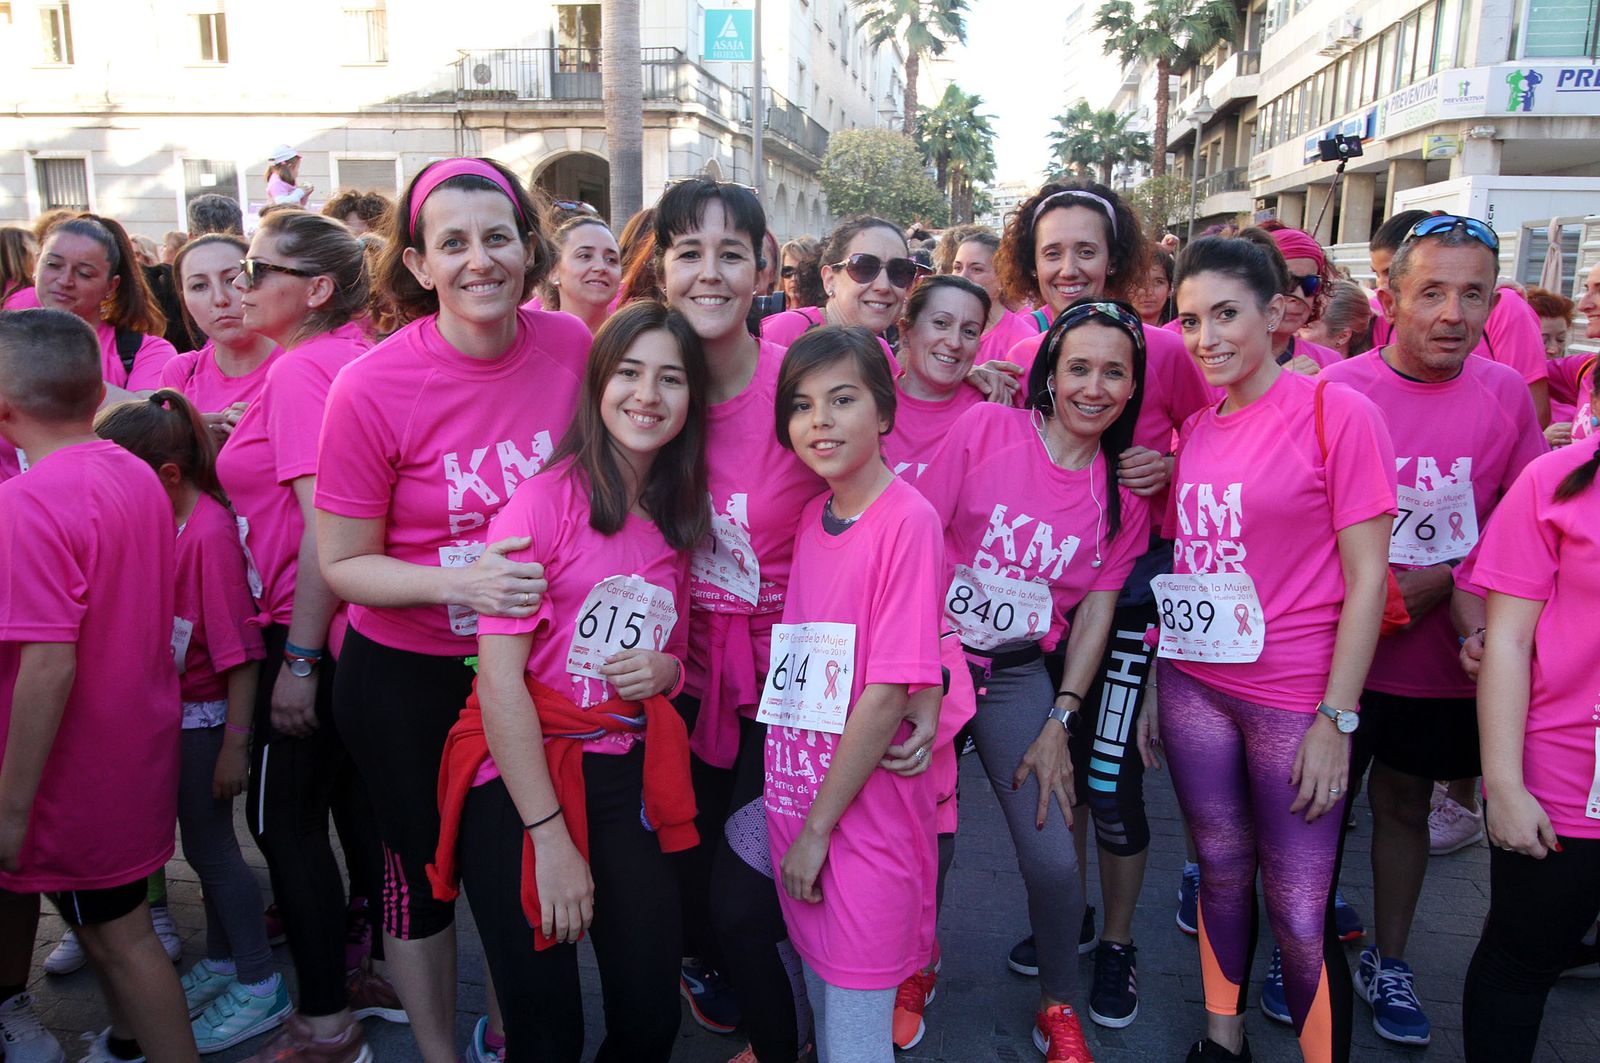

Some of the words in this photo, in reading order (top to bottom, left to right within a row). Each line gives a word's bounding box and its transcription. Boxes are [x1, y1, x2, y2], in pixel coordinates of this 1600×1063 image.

[713, 40, 744, 50] ASAJA
[1390, 78, 1438, 111] PREVENTIVA
[1443, 95, 1484, 104] PREVENTIVA
[1176, 482, 1243, 538] KM
[980, 503, 1081, 580] KM
[606, 582, 635, 600] Carrera
[637, 592, 648, 605] de
[723, 593, 736, 602] de
[758, 592, 784, 604] ujer
[1006, 587, 1017, 596] de
[1018, 590, 1026, 599] la
[1168, 582, 1196, 592] Carrera
[1199, 583, 1209, 592] de
[1211, 583, 1221, 592] la
[1223, 583, 1251, 593] Mujer
[949, 585, 1015, 632] 840
[1162, 598, 1215, 634] 839
[578, 600, 646, 650] 615
[821, 633, 848, 648] Mujer
[772, 653, 810, 692] 614
